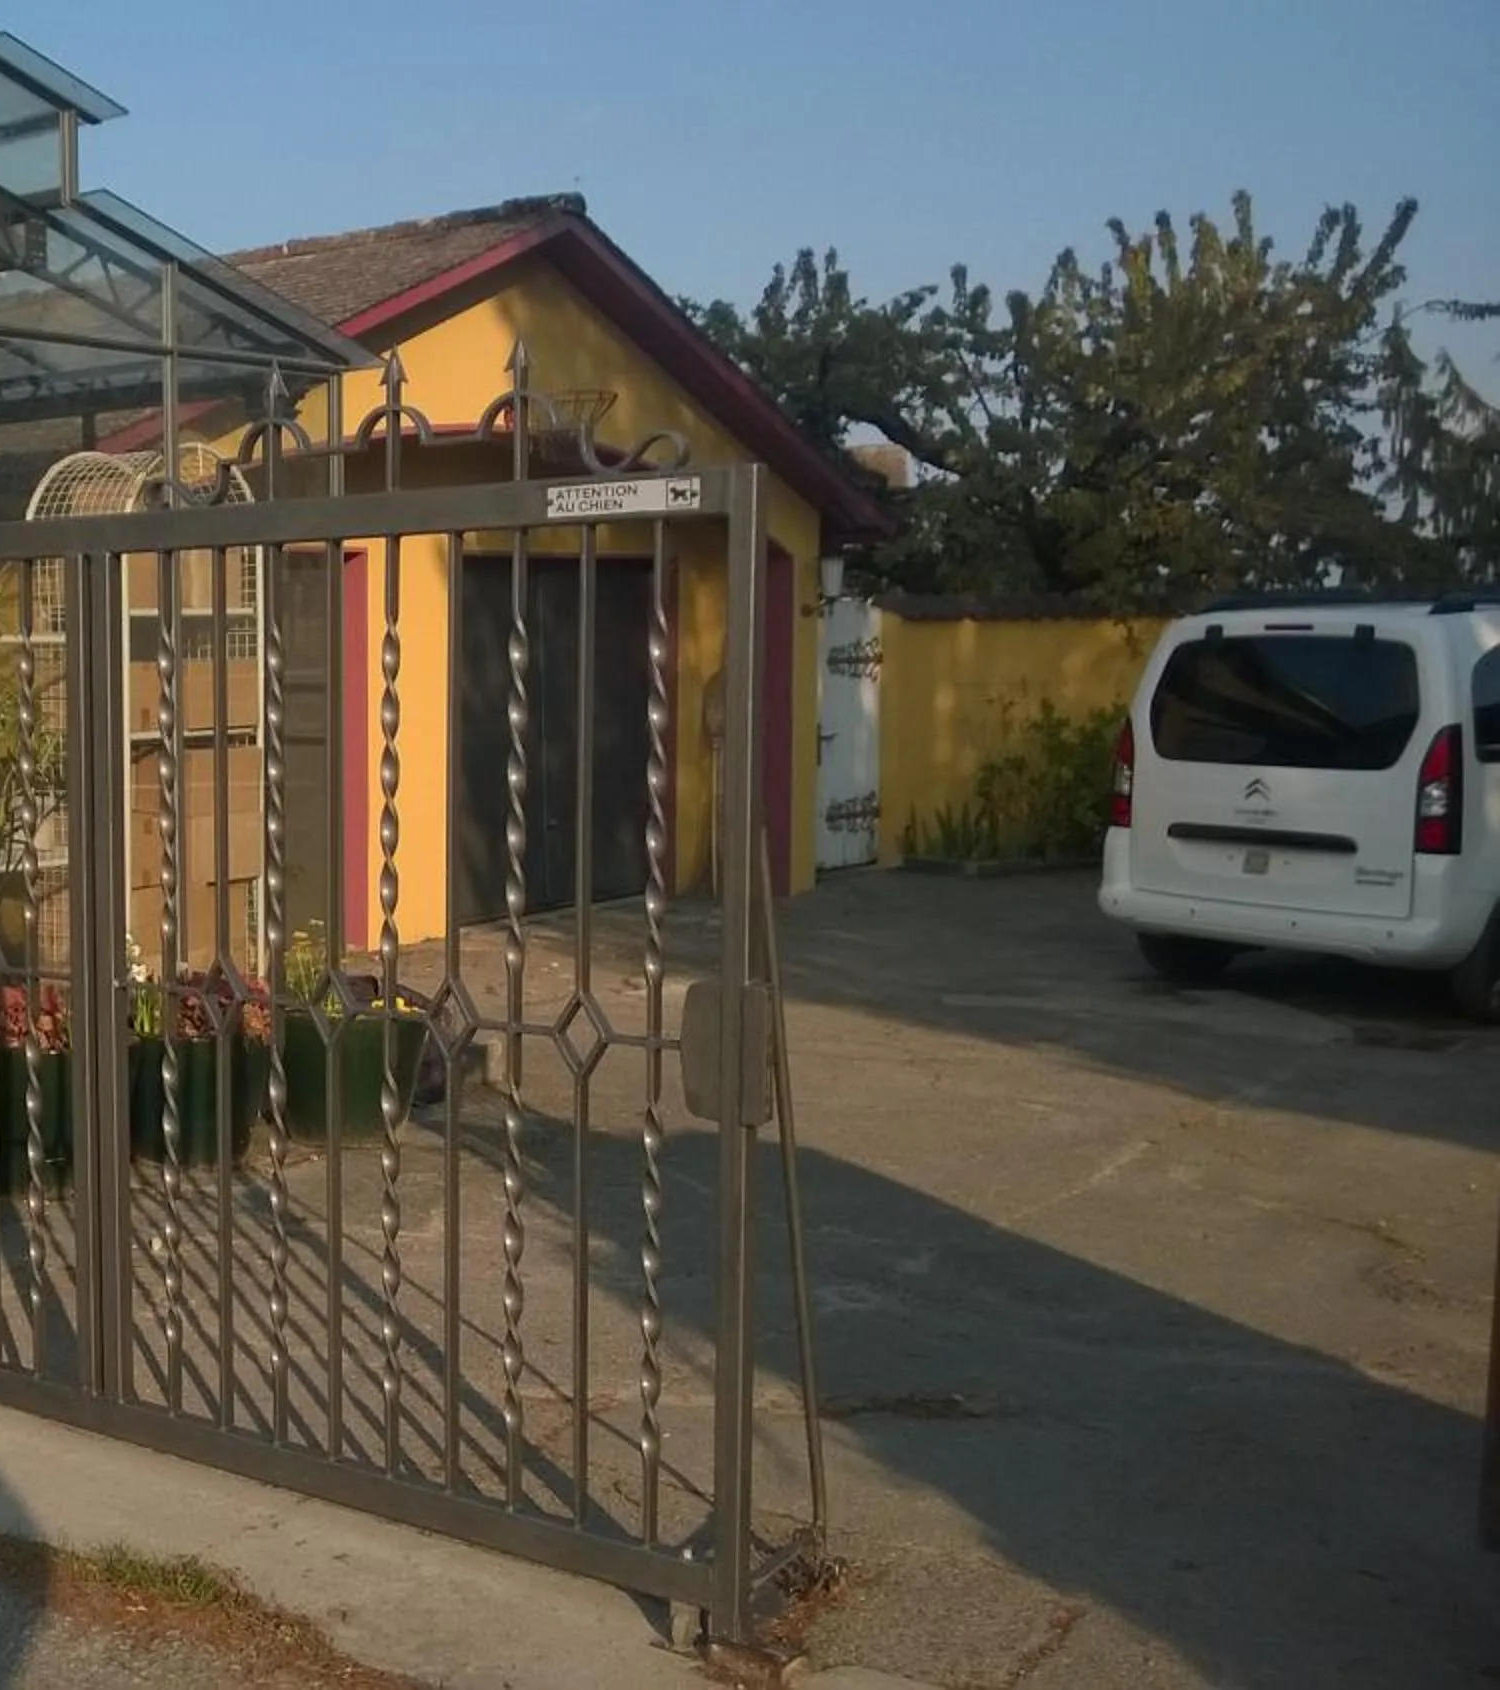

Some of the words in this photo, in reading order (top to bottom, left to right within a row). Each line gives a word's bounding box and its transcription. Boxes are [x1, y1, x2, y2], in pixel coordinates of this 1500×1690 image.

[556, 485, 638, 500] ATTENTION
[556, 501, 575, 512] AU
[579, 499, 623, 511] CHIEN
